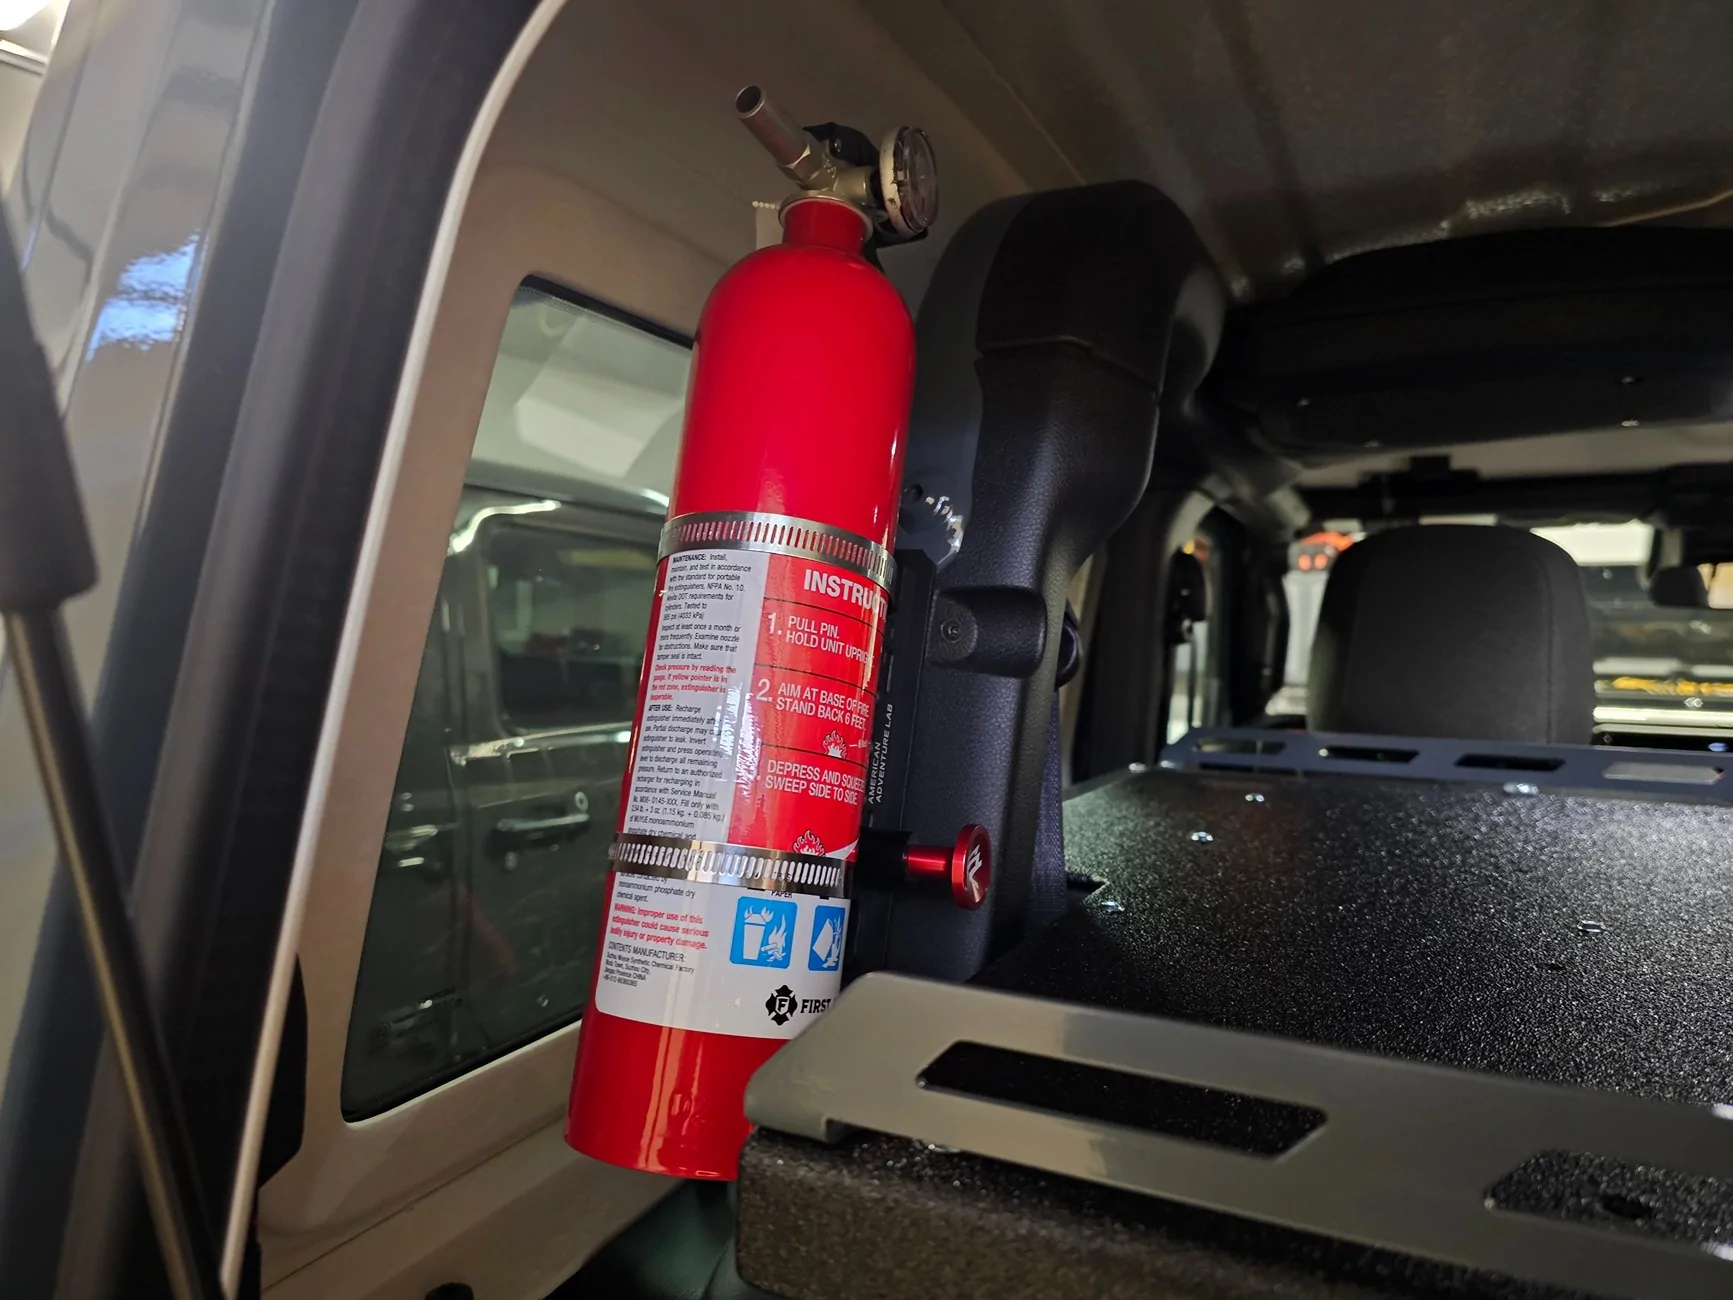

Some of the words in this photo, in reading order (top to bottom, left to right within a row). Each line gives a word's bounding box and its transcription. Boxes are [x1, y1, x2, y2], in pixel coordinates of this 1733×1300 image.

[673, 554, 706, 563] MAINTENANCE:
[717, 564, 751, 572] accordance
[692, 612, 704, 620] kPa)
[768, 612, 782, 635] 1.
[788, 615, 818, 634] PULL
[820, 622, 840, 639] PIN.
[786, 630, 818, 648] HOLD
[821, 638, 845, 655] UNIT
[692, 664, 698, 672] by
[700, 665, 724, 673] reading
[672, 674, 689, 682] yellow
[690, 674, 712, 682] pointer
[681, 684, 718, 693] extinguisher
[756, 678, 772, 702] 2.
[778, 682, 801, 698] AIM
[803, 687, 819, 701] AT
[820, 690, 845, 709] BASE
[846, 698, 856, 712] OF
[675, 704, 701, 714] Recharge
[775, 697, 816, 716] STAND
[818, 704, 844, 723] BACK
[845, 712, 851, 725] 6
[647, 715, 671, 724] extinguisher
[672, 715, 705, 724] immediately
[668, 725, 693, 734] discharge
[689, 737, 706, 745] Invert
[678, 746, 693, 754] press
[694, 748, 723, 758] operating
[655, 756, 678, 764] discharge
[687, 758, 718, 768] remaining
[876, 729, 890, 803] ADVENTURE
[657, 765, 673, 773] Return
[690, 768, 723, 778] authorized
[767, 760, 820, 780] DEPRESS
[821, 769, 841, 785] AND
[868, 742, 881, 804] AMERICAN
[664, 777, 693, 787] recharging
[765, 775, 807, 793] SWEEP
[808, 782, 831, 799] SIDE
[833, 786, 844, 801] TO
[671, 787, 692, 796] Service
[693, 789, 716, 799] Manual
[690, 801, 704, 810] only
[706, 803, 720, 811] with
[677, 809, 686, 818] kg.
[693, 810, 711, 819] 0.085
[713, 812, 725, 823] kg.)
[649, 817, 694, 828] monoammonium
[658, 829, 683, 839] chemical
[634, 893, 648, 902] agent.
[654, 885, 684, 896] phosphate
[685, 888, 695, 899] dry
[614, 903, 636, 914] WARNING:
[637, 907, 665, 919] Improper
[681, 914, 688, 922] of
[690, 914, 703, 924] this
[612, 915, 640, 926] extinguisher
[641, 920, 658, 930] could
[660, 924, 680, 933] cause
[682, 926, 709, 937] serious
[610, 926, 622, 937] bodily
[623, 929, 638, 940] injury
[647, 934, 674, 946] property
[676, 938, 707, 950] damage.
[609, 940, 632, 954] CONTENTS
[632, 946, 686, 962] MANUFACTURER:
[631, 957, 650, 966] Synthetic
[651, 960, 673, 970] Chemical
[675, 964, 694, 974] Factory
[632, 972, 647, 981] CHINA
[800, 998, 832, 1013] FIRST
